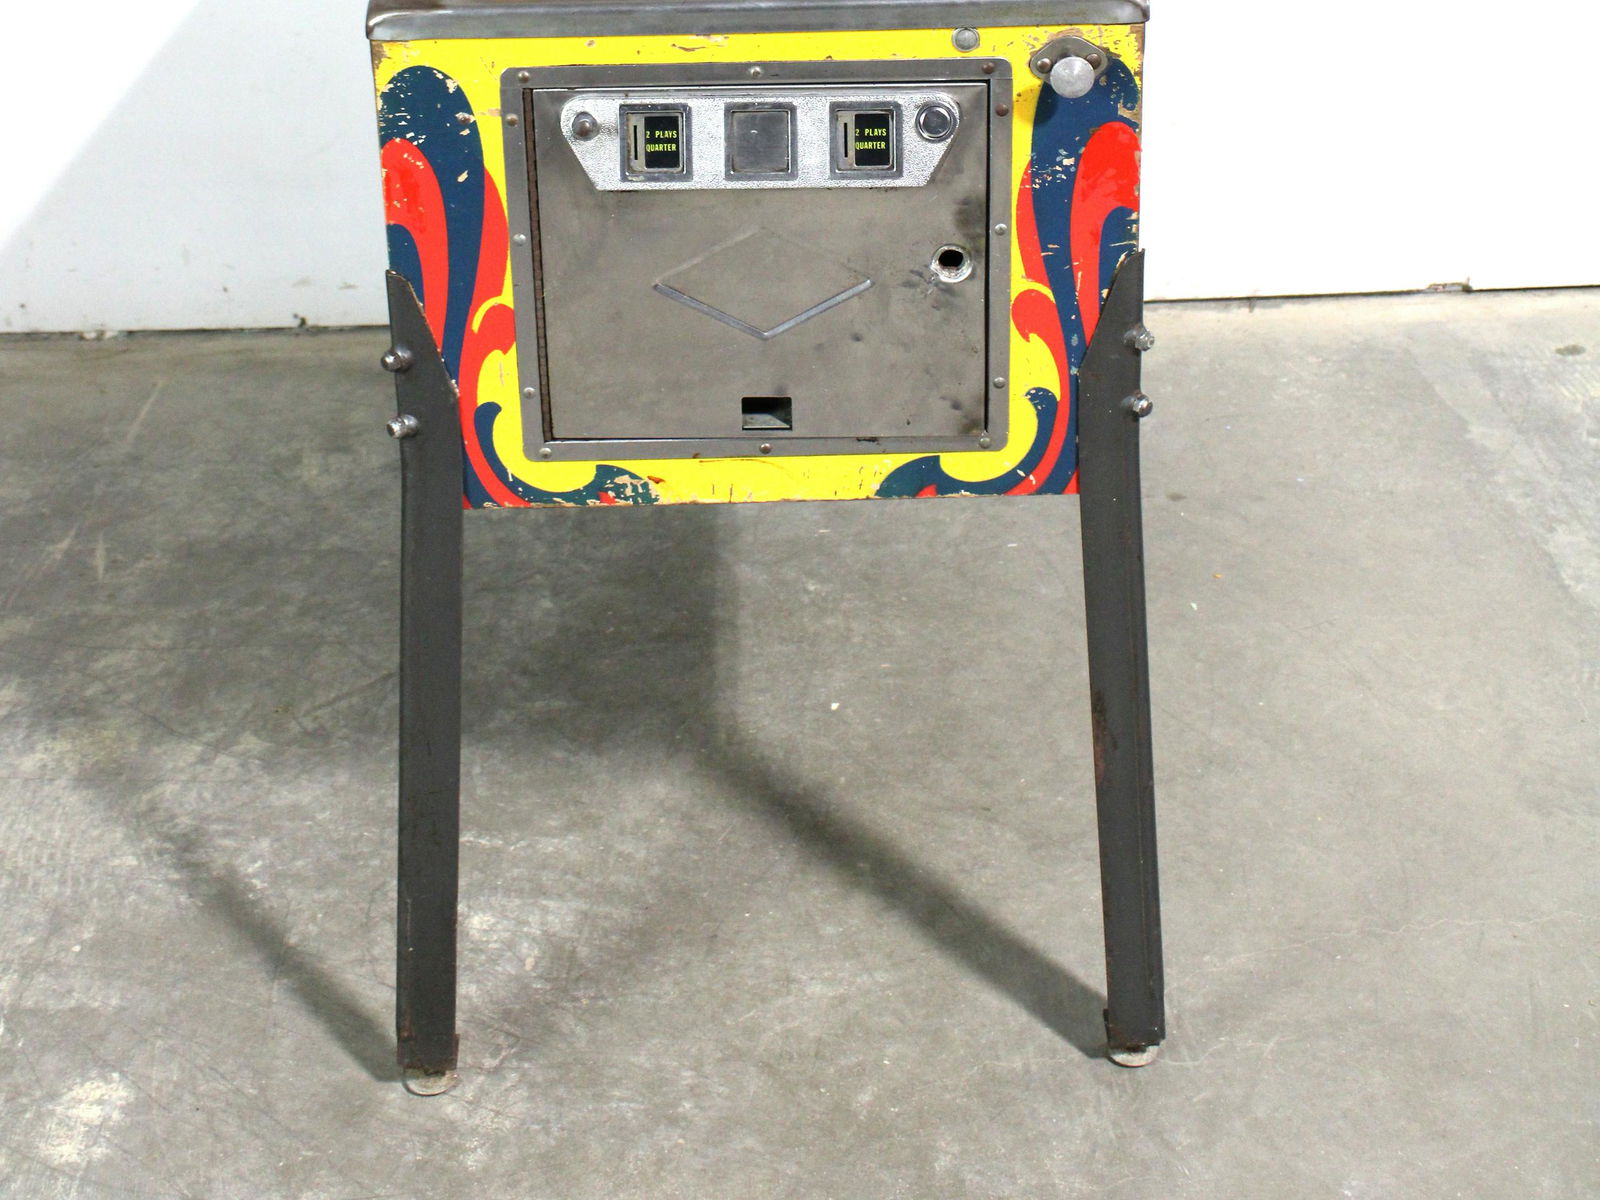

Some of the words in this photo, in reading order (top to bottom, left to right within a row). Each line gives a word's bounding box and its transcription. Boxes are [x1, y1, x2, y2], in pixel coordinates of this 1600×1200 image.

[645, 130, 651, 139] 2
[655, 130, 678, 139] PLAYS
[855, 128, 860, 137] 2
[864, 128, 887, 137] PLAYS
[645, 143, 677, 153] QUARTER
[855, 141, 886, 151] QUARTER
